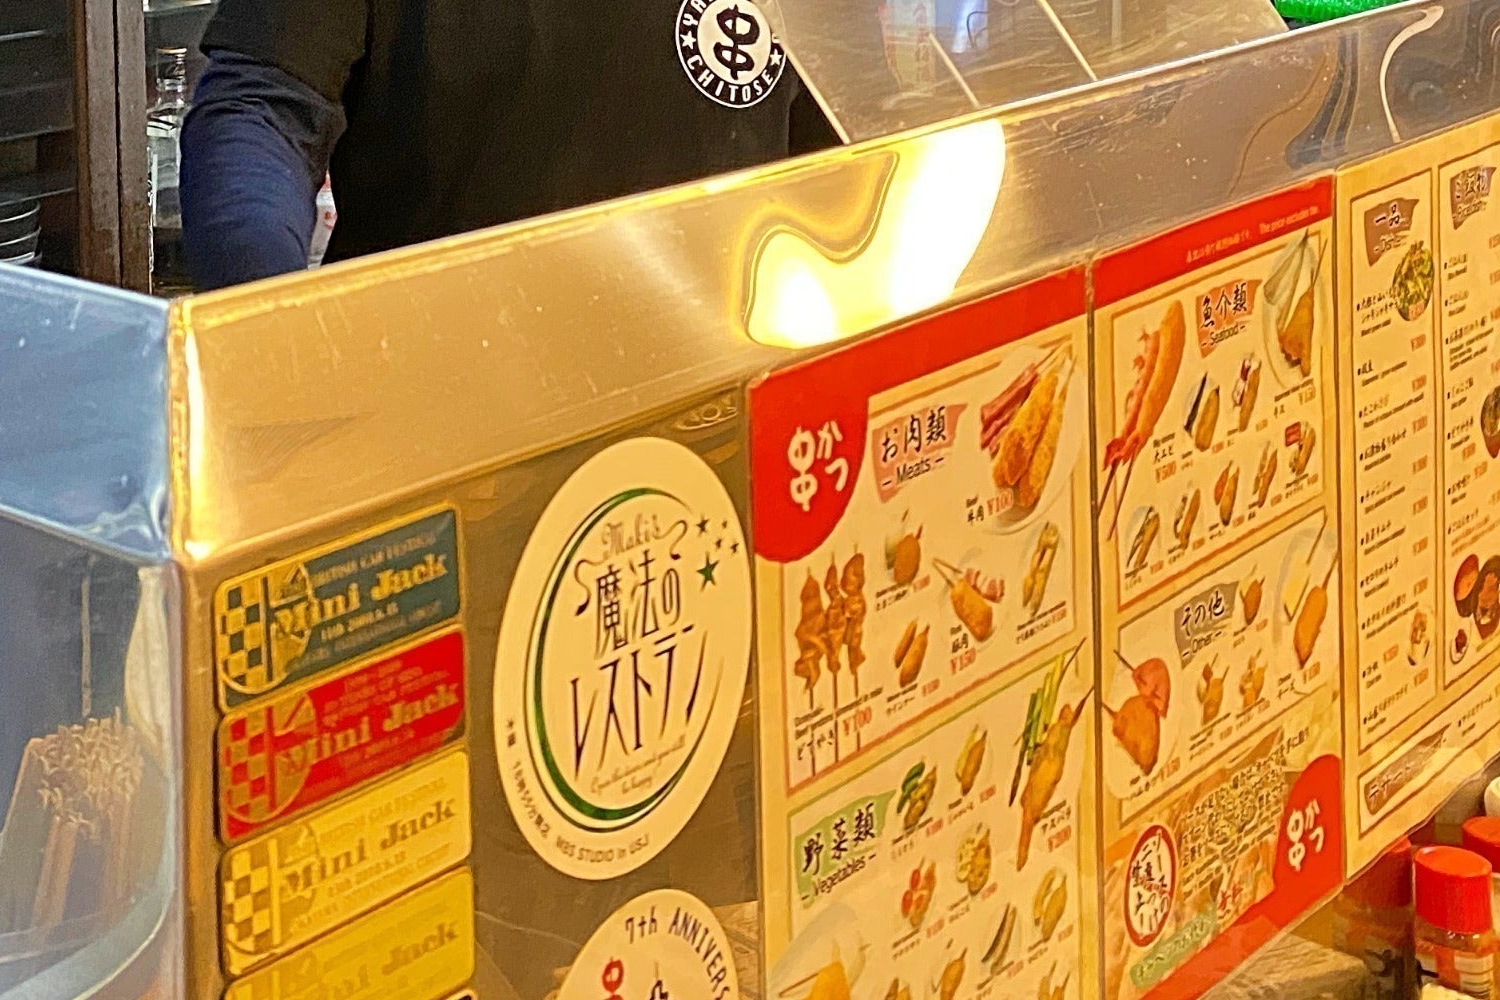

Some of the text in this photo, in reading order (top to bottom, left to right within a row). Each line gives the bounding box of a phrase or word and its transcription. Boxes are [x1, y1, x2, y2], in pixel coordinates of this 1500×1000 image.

[686, 54, 774, 102] CHITOSE
[1202, 281, 1247, 328] 魚介類
[881, 405, 947, 465] お肉類
[787, 420, 849, 512] 串かつ
[895, 455, 932, 486] Meats
[371, 553, 448, 601] Jack
[594, 549, 683, 658] 魔法の
[1182, 590, 1225, 637] その他
[382, 683, 459, 732] Jack
[380, 798, 456, 850] Jack
[578, 847, 615, 863] STUDIO
[629, 832, 649, 855] USJ
[801, 802, 877, 877] 野菜類
[1286, 798, 1325, 872] 串かつ
[813, 857, 867, 896] Vegetables
[381, 920, 460, 976] Jack
[625, 904, 659, 945] 7th
